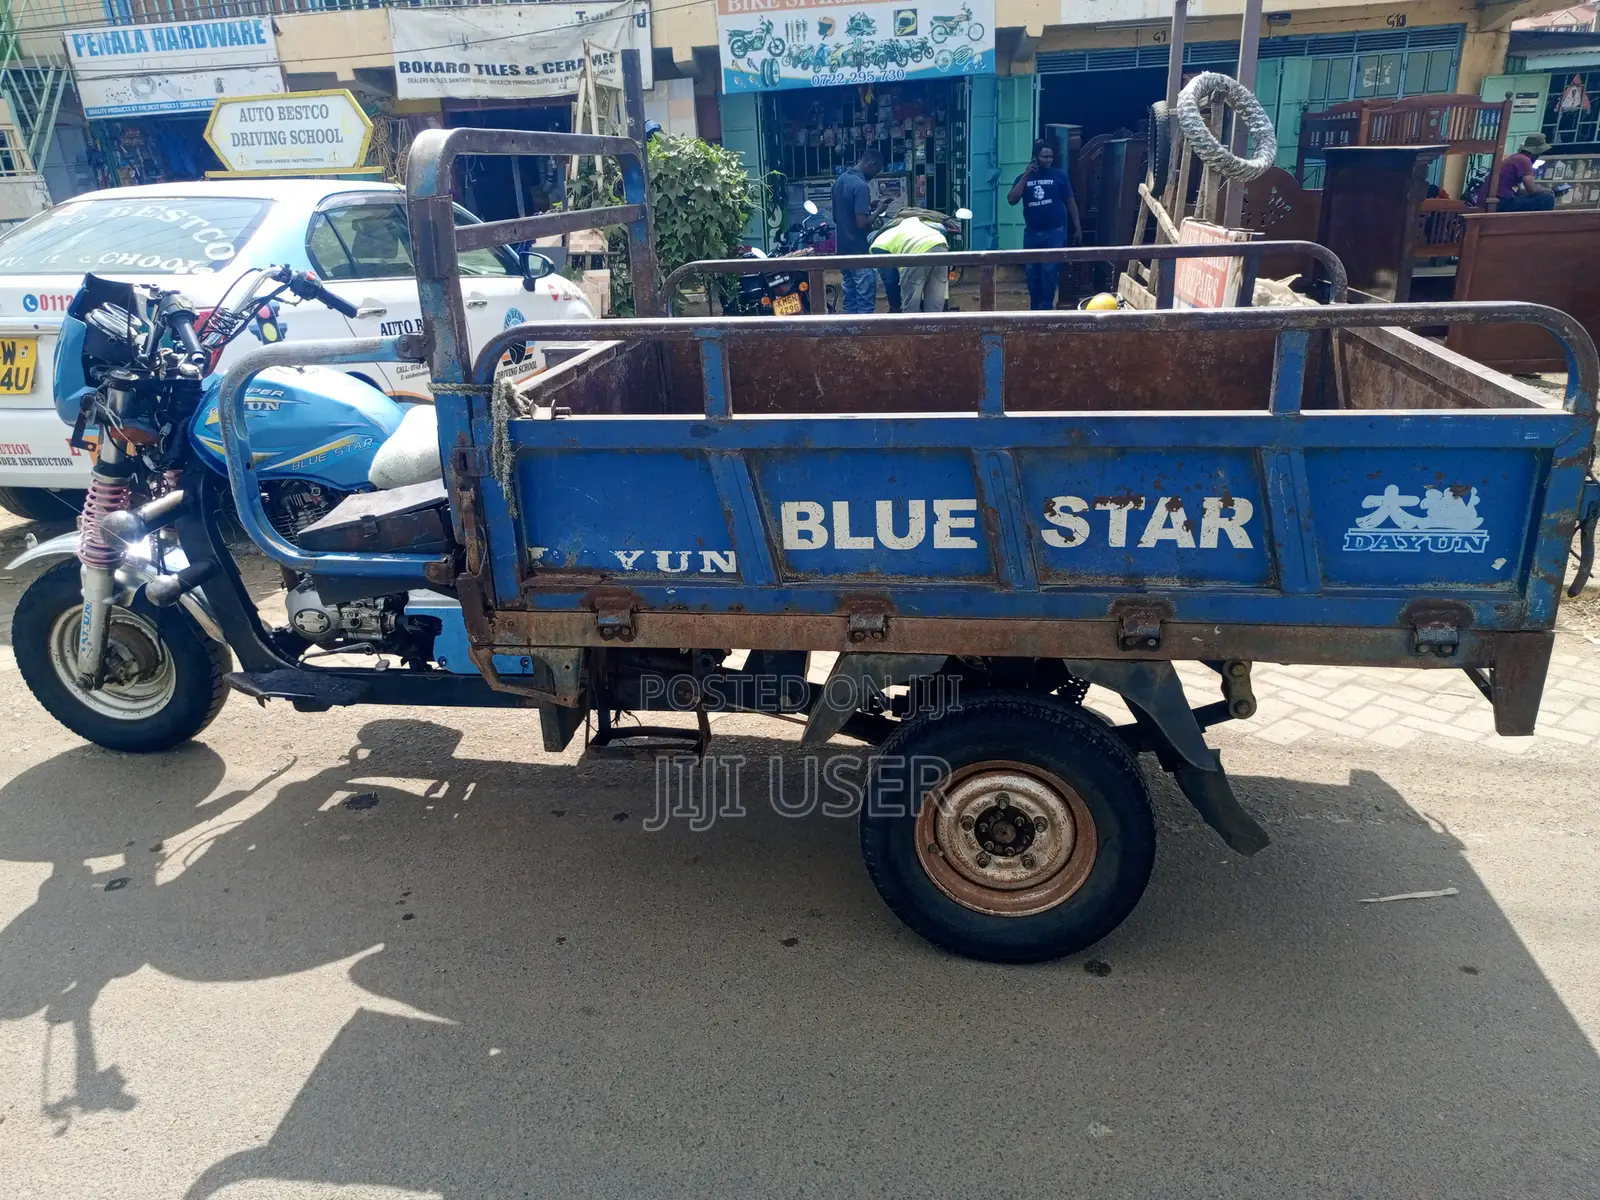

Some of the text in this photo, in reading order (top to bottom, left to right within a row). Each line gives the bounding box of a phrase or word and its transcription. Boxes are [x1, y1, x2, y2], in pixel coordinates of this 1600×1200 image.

[151, 20, 266, 51] HARDWARE
[399, 61, 471, 74] BOKARO
[474, 64, 521, 76] TILES
[525, 65, 539, 76] &
[811, 69, 906, 87] 0722 295 730
[239, 104, 329, 122] AUTO BESTCO
[231, 128, 344, 147] DRIVING SCHOOL
[380, 319, 413, 336] AUTO
[518, 361, 537, 374] SCHOOL
[0, 443, 31, 455] UTION
[292, 438, 373, 471] BLUE STAR
[0, 457, 74, 467] DER INSTRUCTION
[781, 496, 1254, 551] BLUE STAR
[1342, 533, 1490, 553] DAYUN
